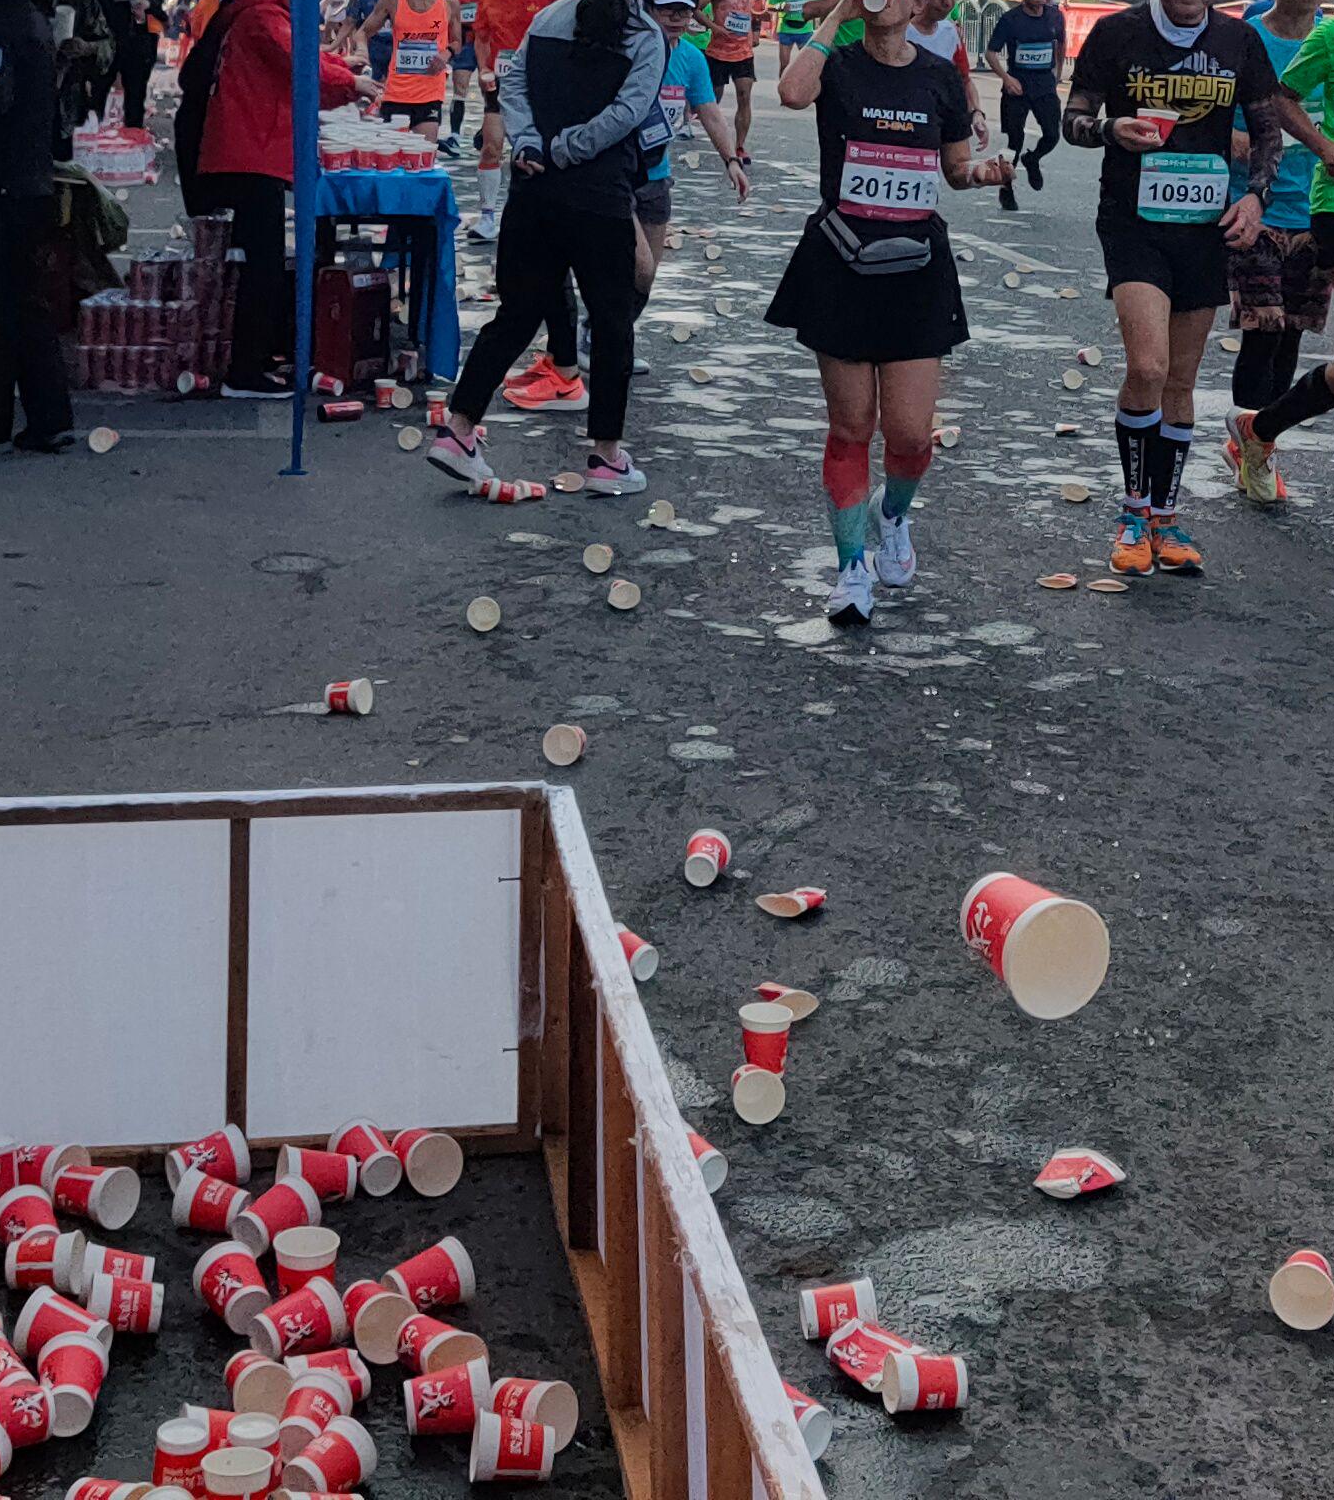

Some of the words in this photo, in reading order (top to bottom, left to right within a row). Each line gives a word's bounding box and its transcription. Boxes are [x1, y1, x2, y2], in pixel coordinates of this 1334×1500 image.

[862, 107, 894, 120] MAXI
[896, 110, 928, 123] RACE
[876, 120, 915, 132] CHINA
[848, 175, 921, 202] 20151
[1148, 182, 1214, 205] 10930
